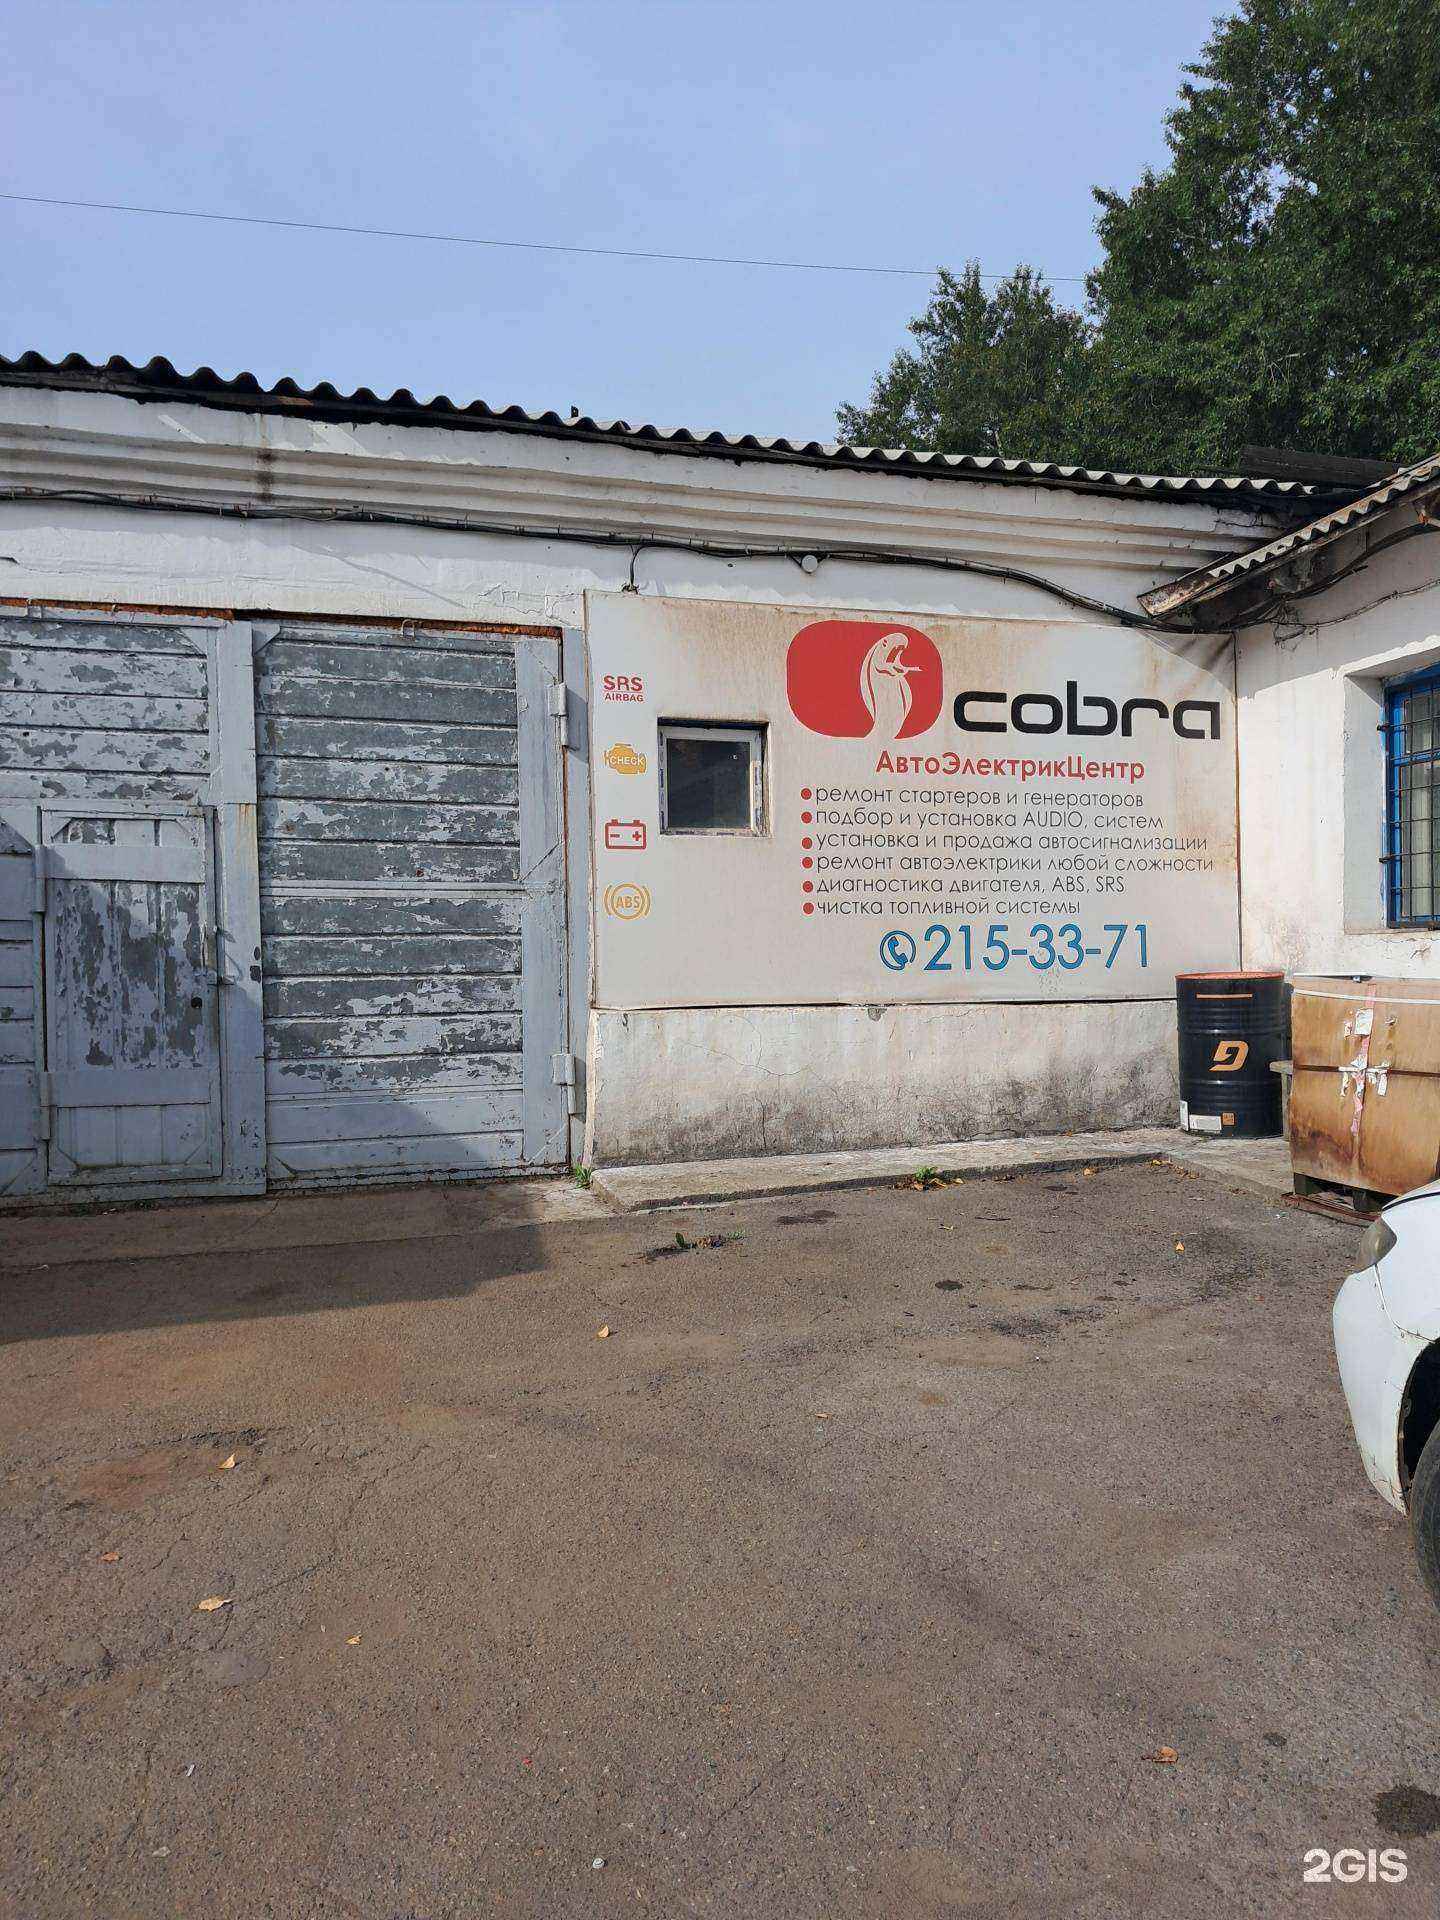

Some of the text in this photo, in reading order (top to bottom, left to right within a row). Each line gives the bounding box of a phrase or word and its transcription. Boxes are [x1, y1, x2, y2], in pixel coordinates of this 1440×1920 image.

[603, 675, 643, 692] SRS
[604, 692, 644, 703] AIRBAG
[953, 680, 1221, 740] cobra
[609, 755, 645, 767] CHECK
[875, 750, 1145, 784] АвтоЭлектрикЦентр
[816, 787, 1144, 810] ремонт стартеров и генераторов
[816, 806, 1164, 830] подбор и установка AUDIO, систем
[816, 832, 1208, 852] установка и продажа автосигнализации
[817, 853, 1214, 874] ремонт автоэлектрики любой сложности
[816, 875, 1126, 894] диагностика двигателя, ABS, SRS
[615, 895, 641, 909] ABS
[816, 896, 1080, 915] чистка топливной системы
[923, 923, 1149, 971] 215-33-71
